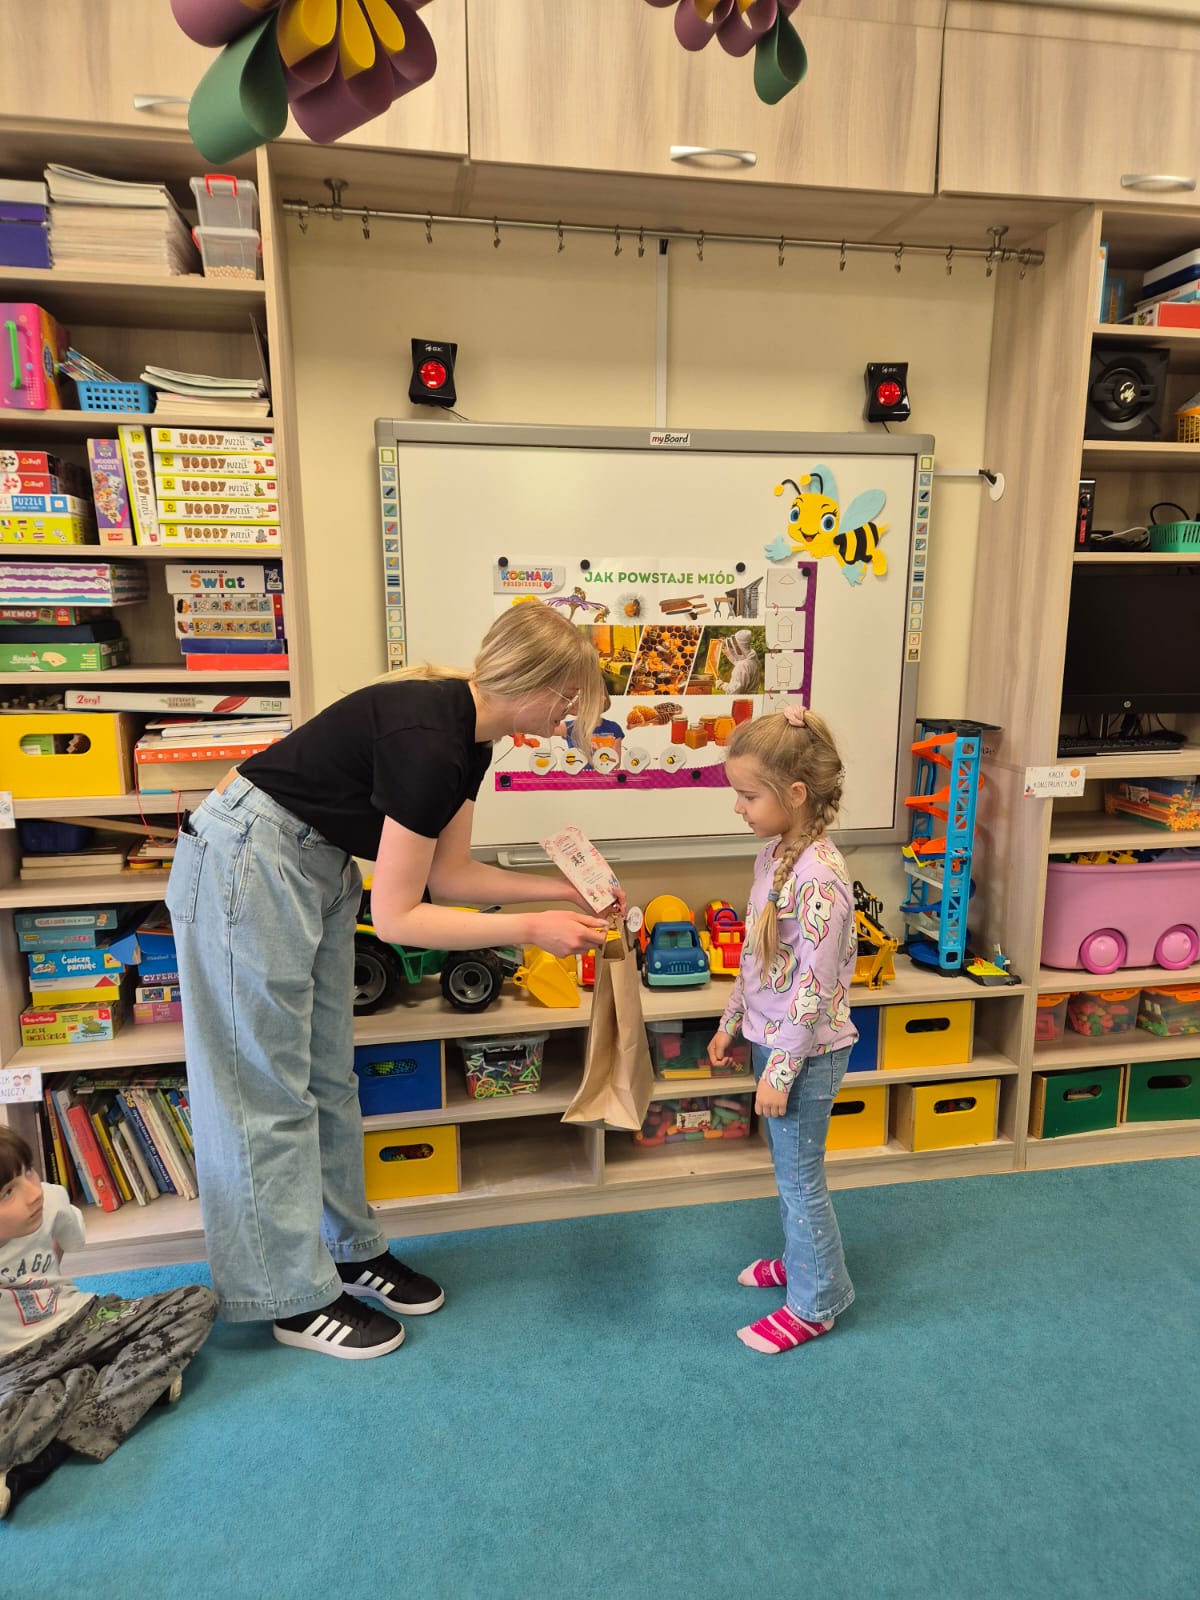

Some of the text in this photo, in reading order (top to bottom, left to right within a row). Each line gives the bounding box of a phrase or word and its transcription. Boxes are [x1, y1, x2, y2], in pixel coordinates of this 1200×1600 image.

[179, 433, 224, 445] WOODY
[652, 434, 689, 444] myBoard
[181, 457, 248, 470] WOODY PUZZLE
[182, 480, 249, 493] WOODY PUZZLE
[13, 497, 43, 506] PUZZLE
[185, 503, 229, 515] WOODY
[184, 527, 228, 539] WOODY
[501, 569, 553, 581] KOCHAM
[584, 570, 735, 585] JAK POWSTAJE MIÓD
